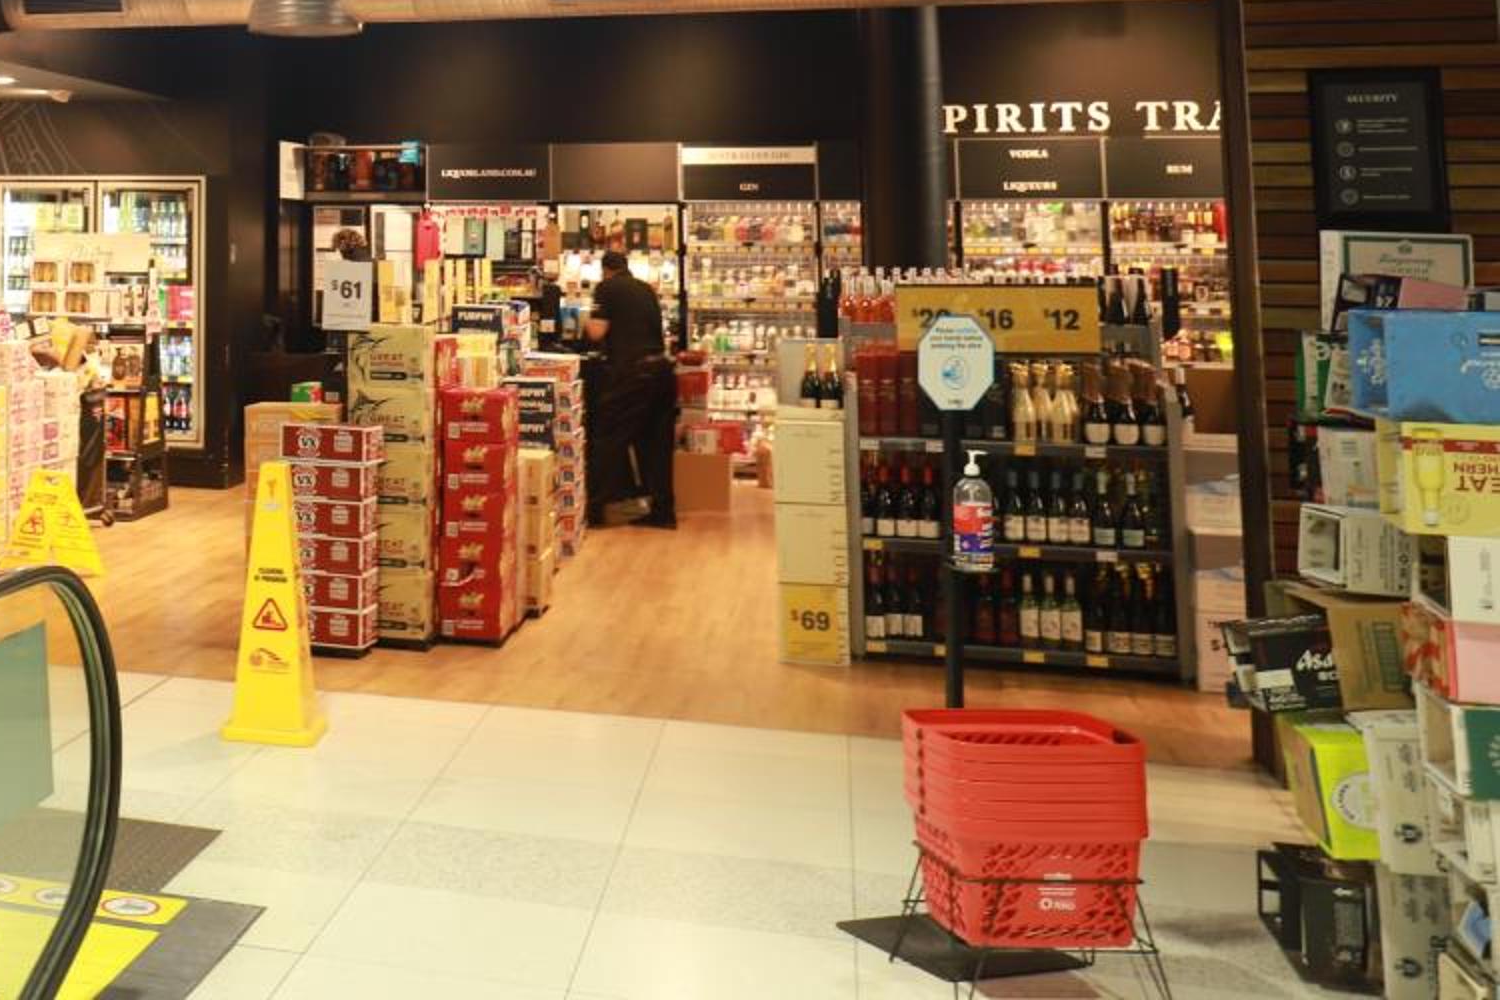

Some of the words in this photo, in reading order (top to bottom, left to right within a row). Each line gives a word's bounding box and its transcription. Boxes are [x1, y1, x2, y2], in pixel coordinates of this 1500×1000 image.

[941, 101, 1111, 133] PIRITS
[331, 279, 363, 299] $61
[1452, 461, 1500, 476] HERN
[789, 608, 831, 632] $69
